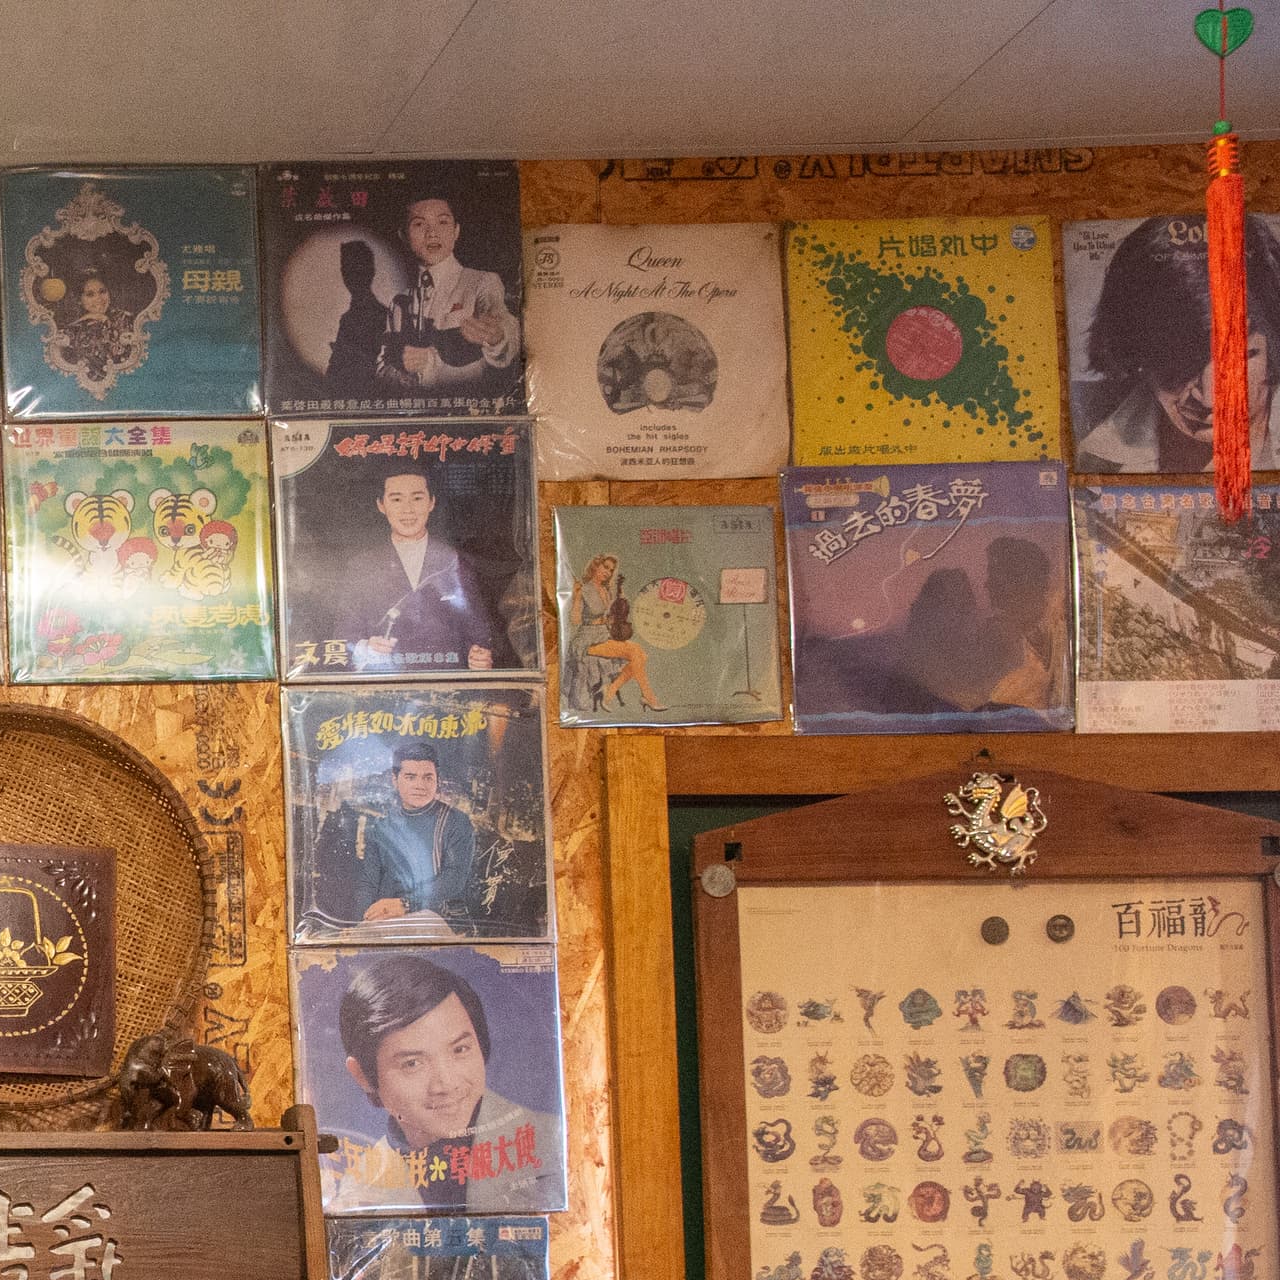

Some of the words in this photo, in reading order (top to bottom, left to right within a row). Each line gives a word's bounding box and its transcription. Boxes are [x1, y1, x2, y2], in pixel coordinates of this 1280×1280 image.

[627, 247, 684, 269] Queen
[592, 281, 639, 304] Night
[698, 281, 738, 304] Opera
[14, 426, 172, 448] 世界童話大全集
[606, 446, 654, 454] BOHEMIAN
[316, 708, 486, 751] 愛情如水向東流
